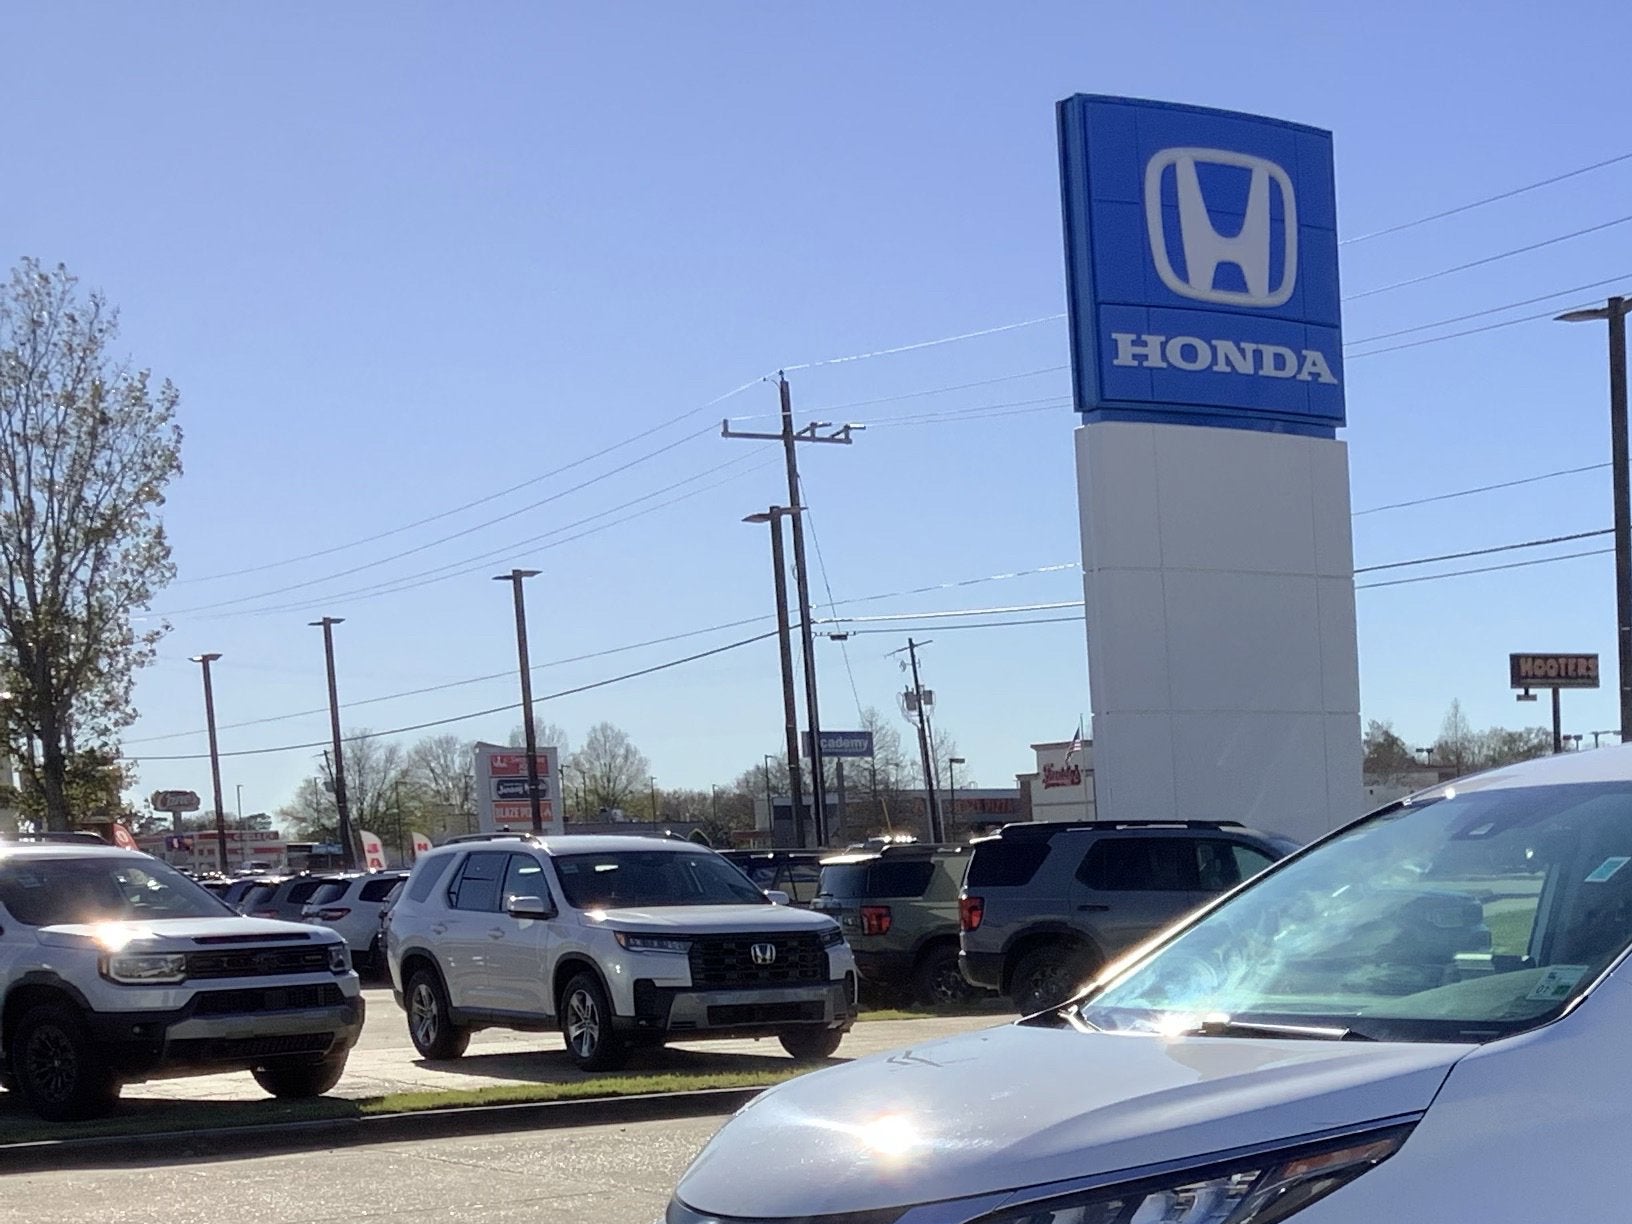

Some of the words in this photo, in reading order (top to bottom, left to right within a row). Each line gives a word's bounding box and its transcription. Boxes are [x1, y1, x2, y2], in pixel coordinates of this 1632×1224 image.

[1111, 332, 1338, 385] HONDA
[1520, 657, 1597, 677] HOOTERS
[819, 736, 868, 752] cademy
